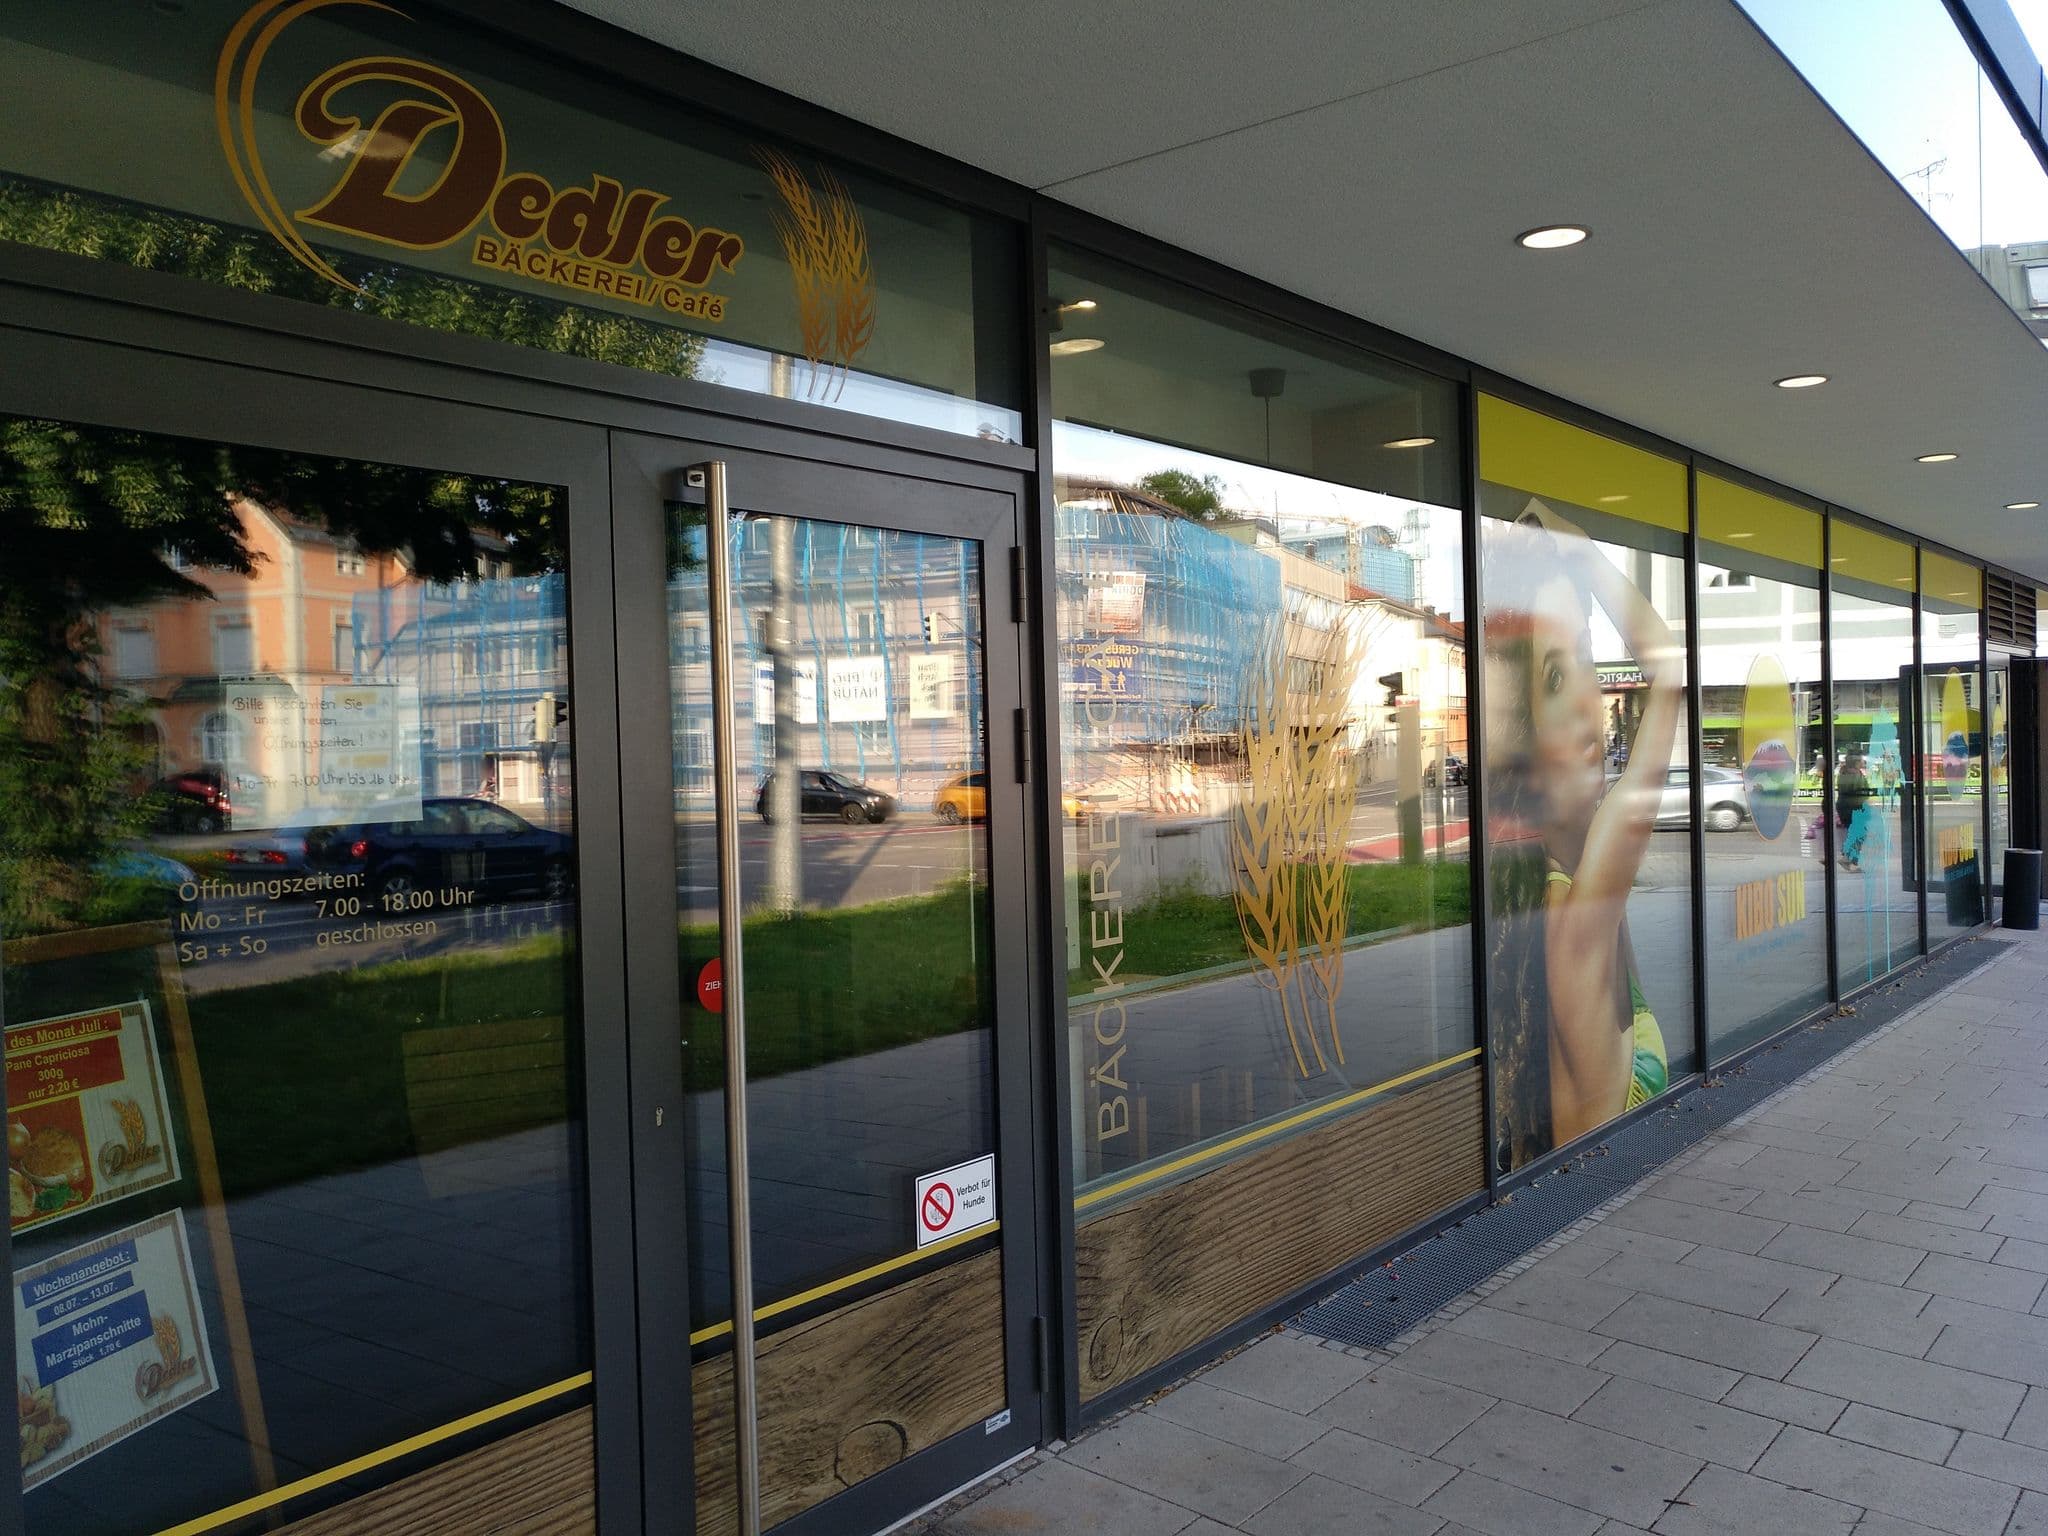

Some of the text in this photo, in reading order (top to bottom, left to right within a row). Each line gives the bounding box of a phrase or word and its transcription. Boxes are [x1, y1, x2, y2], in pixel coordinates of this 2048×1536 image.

[295, 56, 745, 288] Dedler
[235, 697, 264, 711] Bitte
[344, 698, 363, 711] Sie
[322, 772, 343, 785] Uhr
[348, 772, 366, 785] bis
[178, 871, 366, 902] Öffnungszeiten:
[180, 911, 221, 933] Mo
[245, 905, 268, 926] Fr
[315, 896, 361, 919] 7.00
[381, 889, 434, 913] 18.00
[440, 886, 475, 907] Uhr
[180, 941, 208, 963] Sa
[239, 935, 268, 956] So
[316, 920, 437, 950] geschlossen
[1087, 794, 1129, 1142] BÄCKEREI
[10, 1035, 33, 1049] des
[36, 1025, 76, 1043] Monat
[5, 1058, 32, 1073] Pane
[38, 1068, 64, 1081] 300g
[28, 1088, 45, 1100] nur
[956, 1178, 991, 1197] Verbot für
[962, 1195, 986, 1210] Hunde
[33, 1251, 125, 1298] Wochenangebot
[72, 1315, 109, 1336] Mohn-
[45, 1317, 142, 1369] Marzipanschnitte
